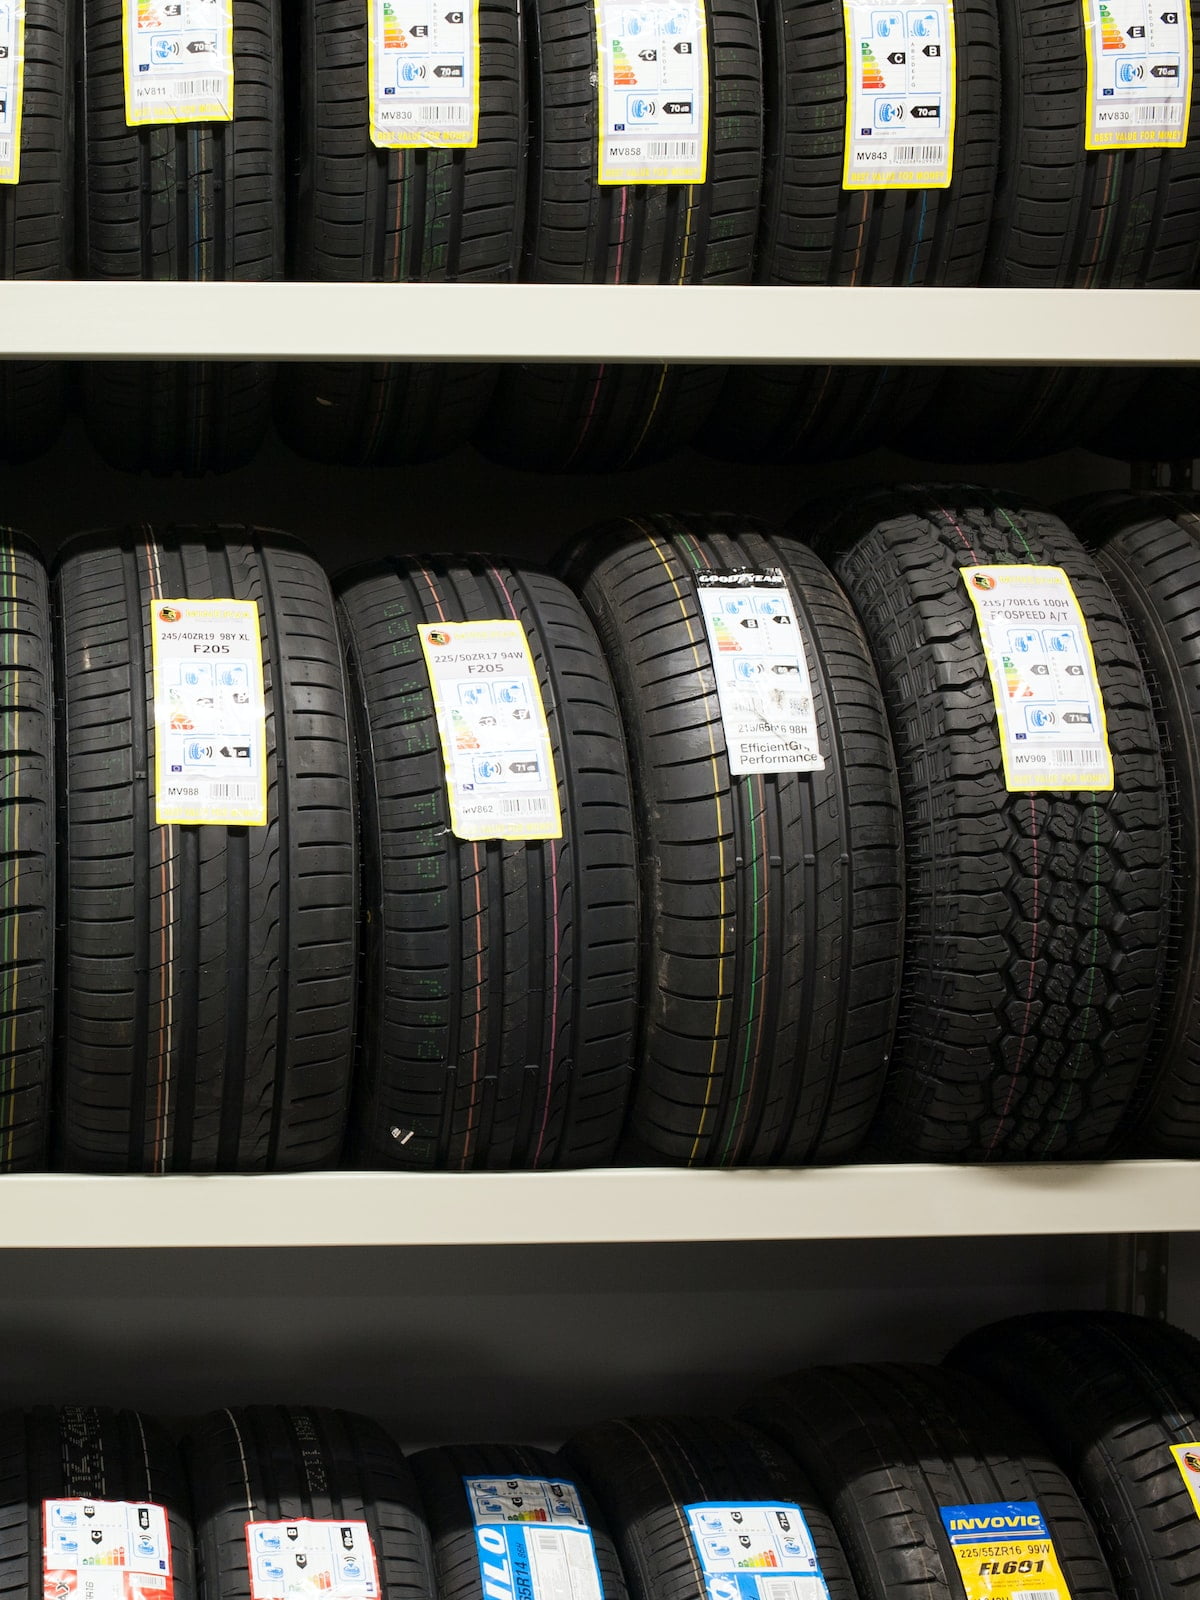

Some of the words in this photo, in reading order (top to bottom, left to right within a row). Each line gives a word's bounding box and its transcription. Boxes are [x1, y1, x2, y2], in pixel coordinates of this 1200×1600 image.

[452, 13, 461, 23] C
[1166, 13, 1176, 23] C
[416, 27, 425, 37] E
[1132, 27, 1142, 37] E
[680, 43, 689, 53] B
[928, 46, 937, 56] B
[894, 53, 903, 64] C
[381, 111, 413, 120] MV830
[1098, 111, 1130, 121] MV830
[609, 147, 641, 156] MV858
[856, 152, 888, 161] MV843
[699, 573, 783, 584] GOODYEAR
[982, 599, 1040, 607] 215/70R16
[1044, 599, 1070, 608] 100H
[1049, 611, 1068, 622] A/T
[161, 633, 215, 641] 245/40ZR19
[220, 633, 236, 641] 98Y
[238, 633, 250, 641] XL
[193, 645, 230, 654] F205
[434, 653, 498, 663] 225/50ZR17
[501, 652, 524, 660] 94W
[467, 664, 504, 674] F205
[1037, 665, 1046, 675] C
[1072, 666, 1080, 675] C
[789, 725, 808, 734] 98H
[740, 753, 818, 765] Performance
[1015, 755, 1047, 763] MV909
[168, 787, 199, 796] MV988
[950, 1515, 1041, 1531] INVOVIC
[960, 1546, 1022, 1558] 225/55ZR16
[1027, 1544, 1050, 1554] 99W
